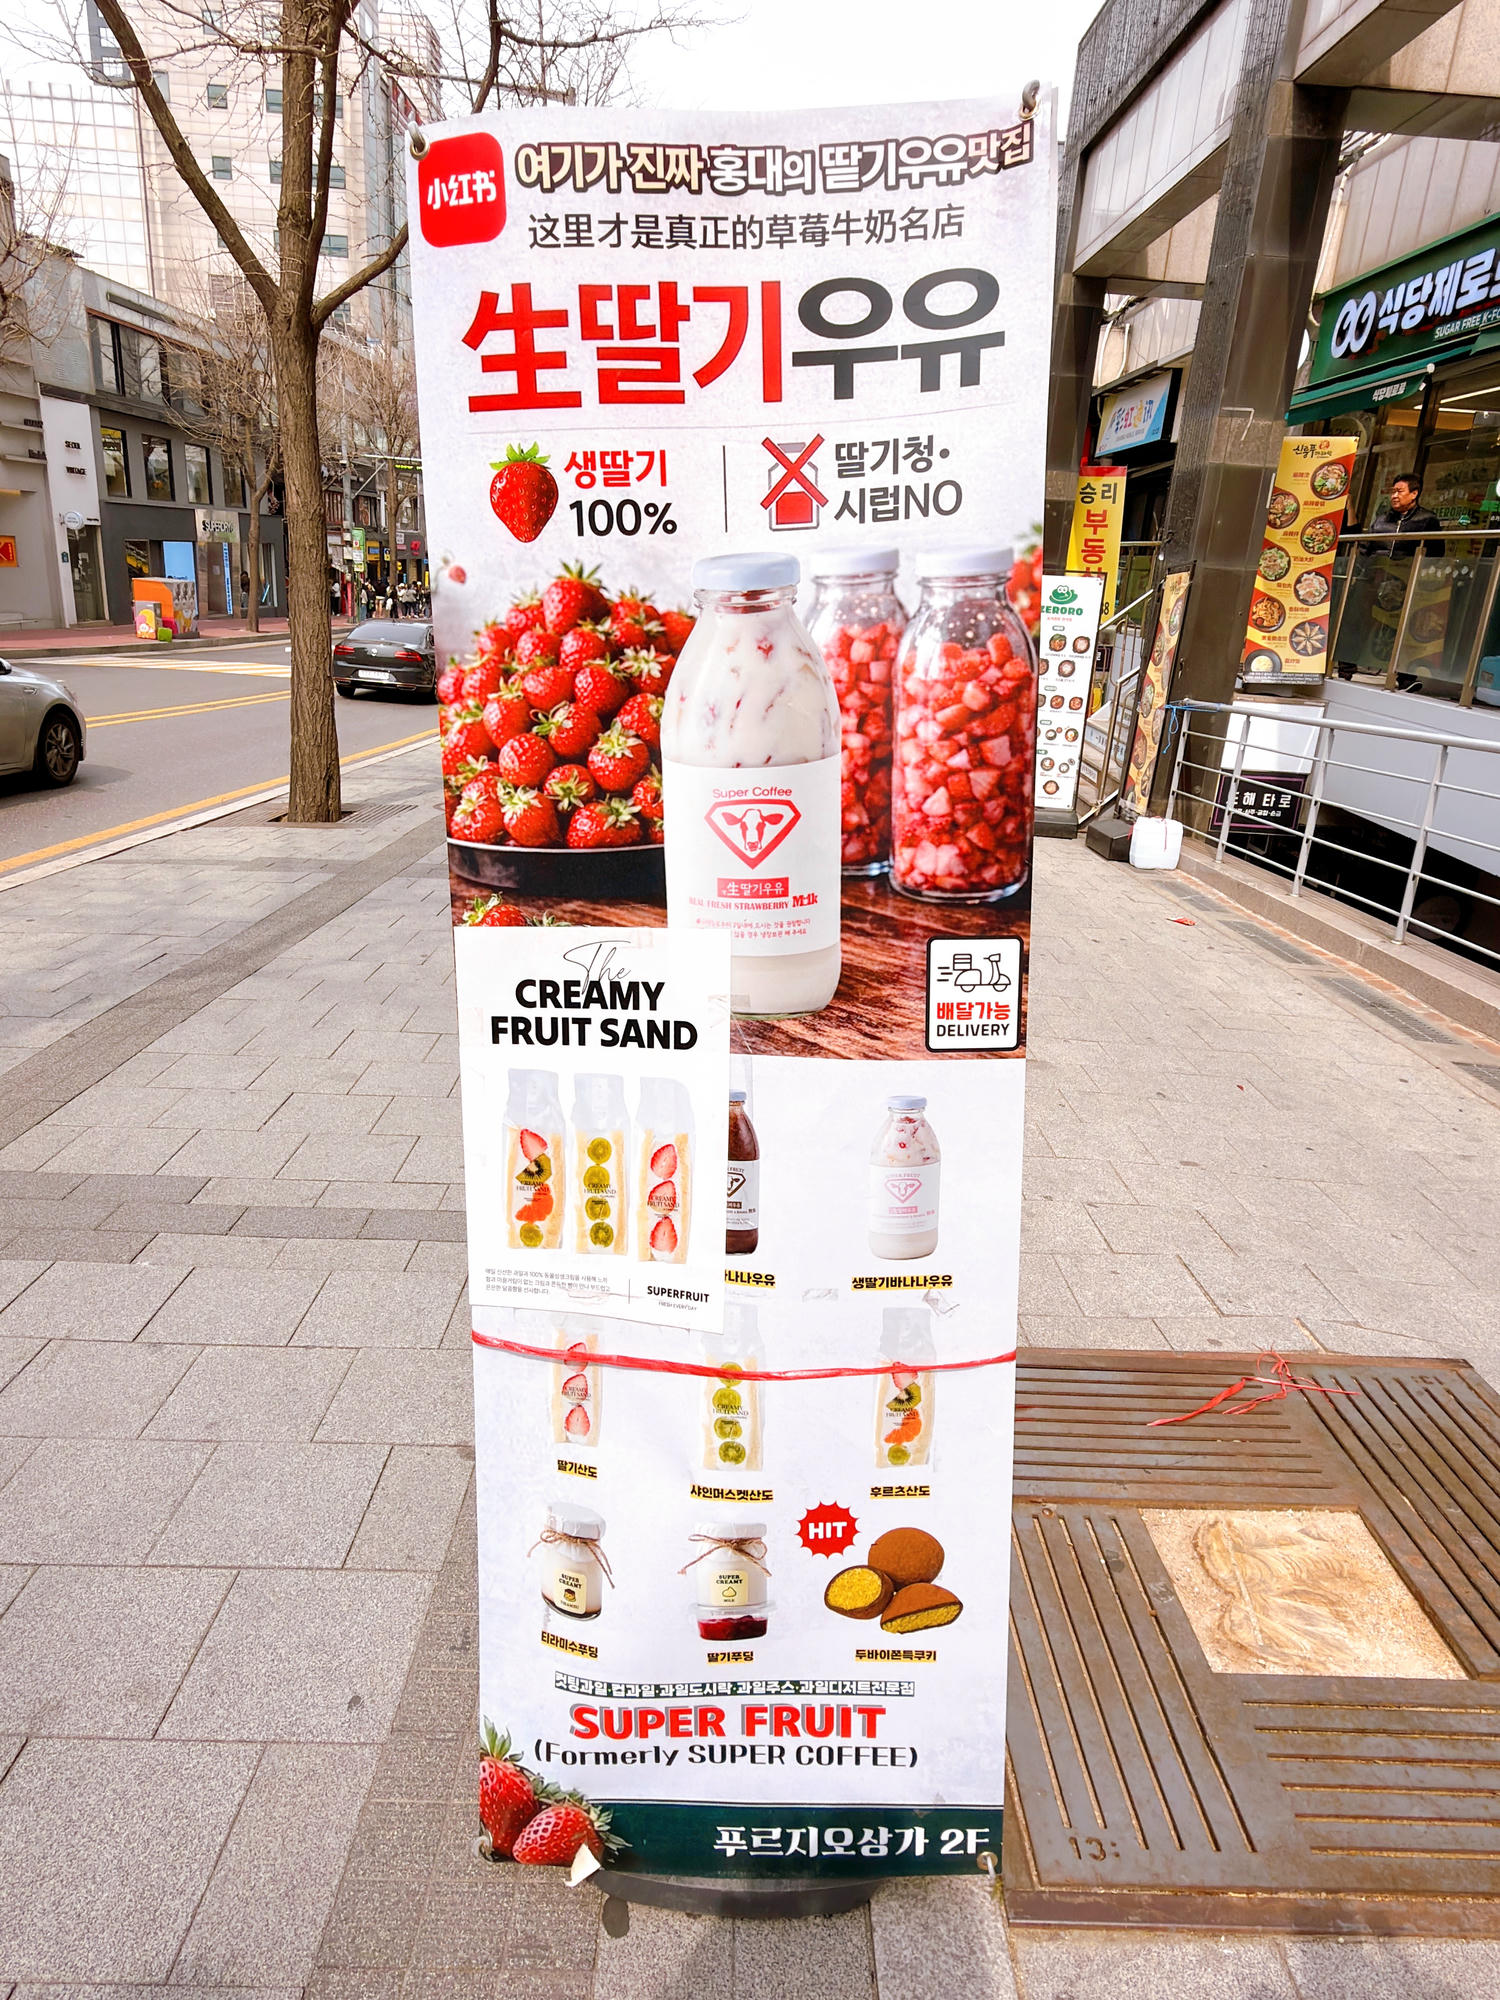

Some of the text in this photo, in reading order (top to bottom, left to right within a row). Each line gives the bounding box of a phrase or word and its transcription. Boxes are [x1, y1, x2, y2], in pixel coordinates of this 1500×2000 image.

[516, 120, 1034, 196] 여기가 진짜 홍대의 딸기우유맛집
[427, 169, 497, 209] 小红书
[529, 203, 964, 250] 这里才是真正的草莓牛奶名店
[1378, 248, 1500, 334] 식당제로
[1434, 321, 1460, 340] SUGAR
[1461, 315, 1481, 332] FREE
[462, 267, 1006, 413] 生딸기우유
[564, 448, 668, 490] 생딸기
[833, 478, 962, 524] 시럽NO
[1079, 482, 1118, 505] 승리
[569, 498, 678, 537] 100%
[713, 786, 792, 798] Super Coffee
[1262, 793, 1292, 808] 타로
[726, 881, 784, 896] 生딸기우유
[707, 900, 732, 910] FRESH
[734, 901, 789, 911] STRAWBERRY
[563, 940, 631, 995] The
[515, 979, 665, 1011] CREAMY
[937, 1002, 1010, 1020] 배달가능
[491, 1016, 698, 1050] FRUIT SAND
[937, 1023, 1010, 1037] DELIVERY
[725, 1269, 775, 1286] 나나우유
[852, 1275, 953, 1289] 생딸기바나나우유
[647, 1285, 710, 1303] SUPERFRUIT
[557, 1459, 597, 1478] 딸기산도
[690, 1484, 773, 1501] 샤인머스켓산도
[870, 1485, 930, 1497] 후르츠산도
[809, 1521, 847, 1539] HIT
[559, 1578, 582, 1589] CREAMY
[562, 1573, 579, 1583] SUPER
[541, 1630, 598, 1659] 티라미수푸딩
[855, 1649, 936, 1661] 두바이쫀득쿠키
[707, 1651, 754, 1662] 딸기푸딩
[570, 1703, 886, 1739] SUPER FRUIT
[534, 1739, 918, 1768] (Formerly SUPER COFFEE)
[713, 1825, 990, 1857] 푸르지오상가 2F
